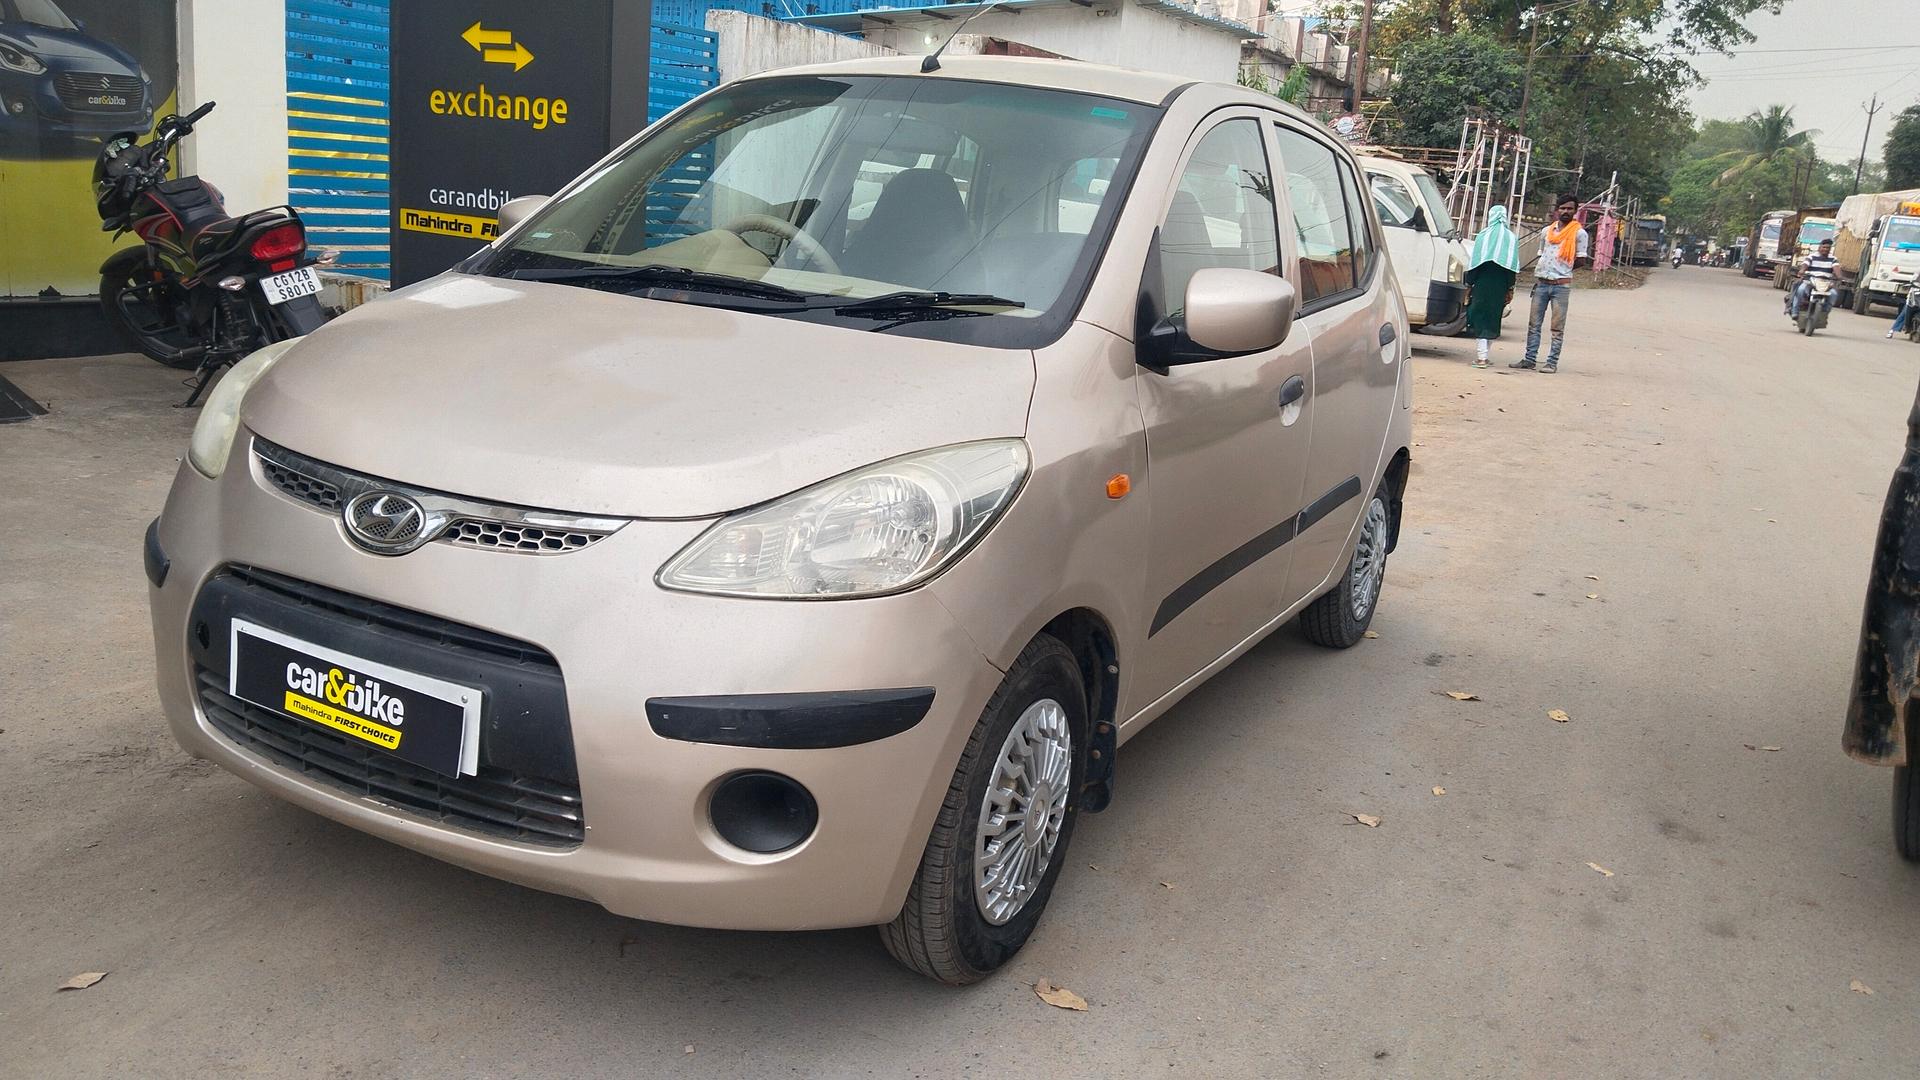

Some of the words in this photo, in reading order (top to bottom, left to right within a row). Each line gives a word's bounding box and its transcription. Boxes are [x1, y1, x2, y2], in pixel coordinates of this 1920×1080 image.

[88, 95, 126, 105] car&bike
[430, 84, 568, 130] exchange
[406, 212, 472, 234] Mahindra
[480, 222, 499, 237] FI
[273, 269, 310, 288] CG12B
[279, 281, 316, 300] S8016
[286, 662, 405, 726] car&bike
[334, 716, 362, 731] FIRST
[361, 726, 396, 744] CHOICE
